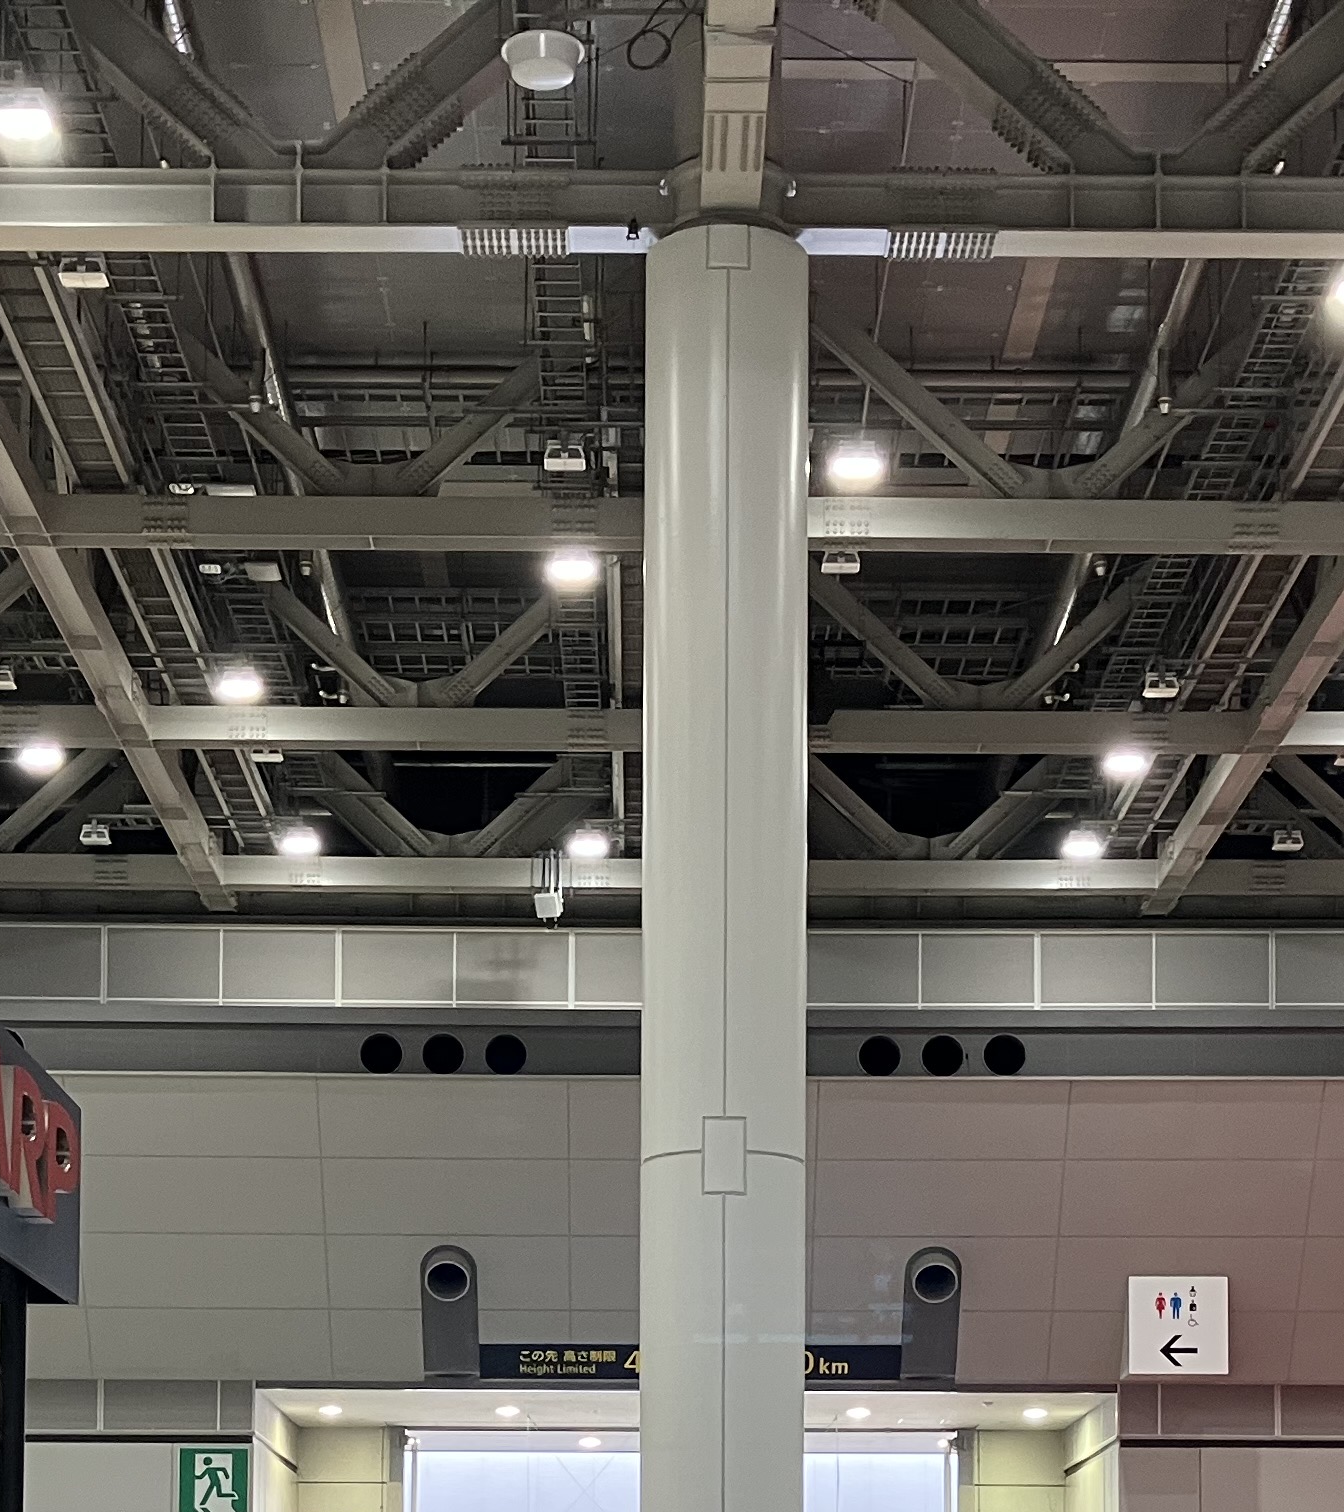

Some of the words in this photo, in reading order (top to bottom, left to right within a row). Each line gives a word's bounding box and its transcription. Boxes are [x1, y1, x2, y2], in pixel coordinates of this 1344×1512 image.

[519, 1350, 558, 1362] この先
[563, 1350, 616, 1362] 高さ制限
[519, 1363, 554, 1376] Height
[557, 1363, 596, 1374] Limited
